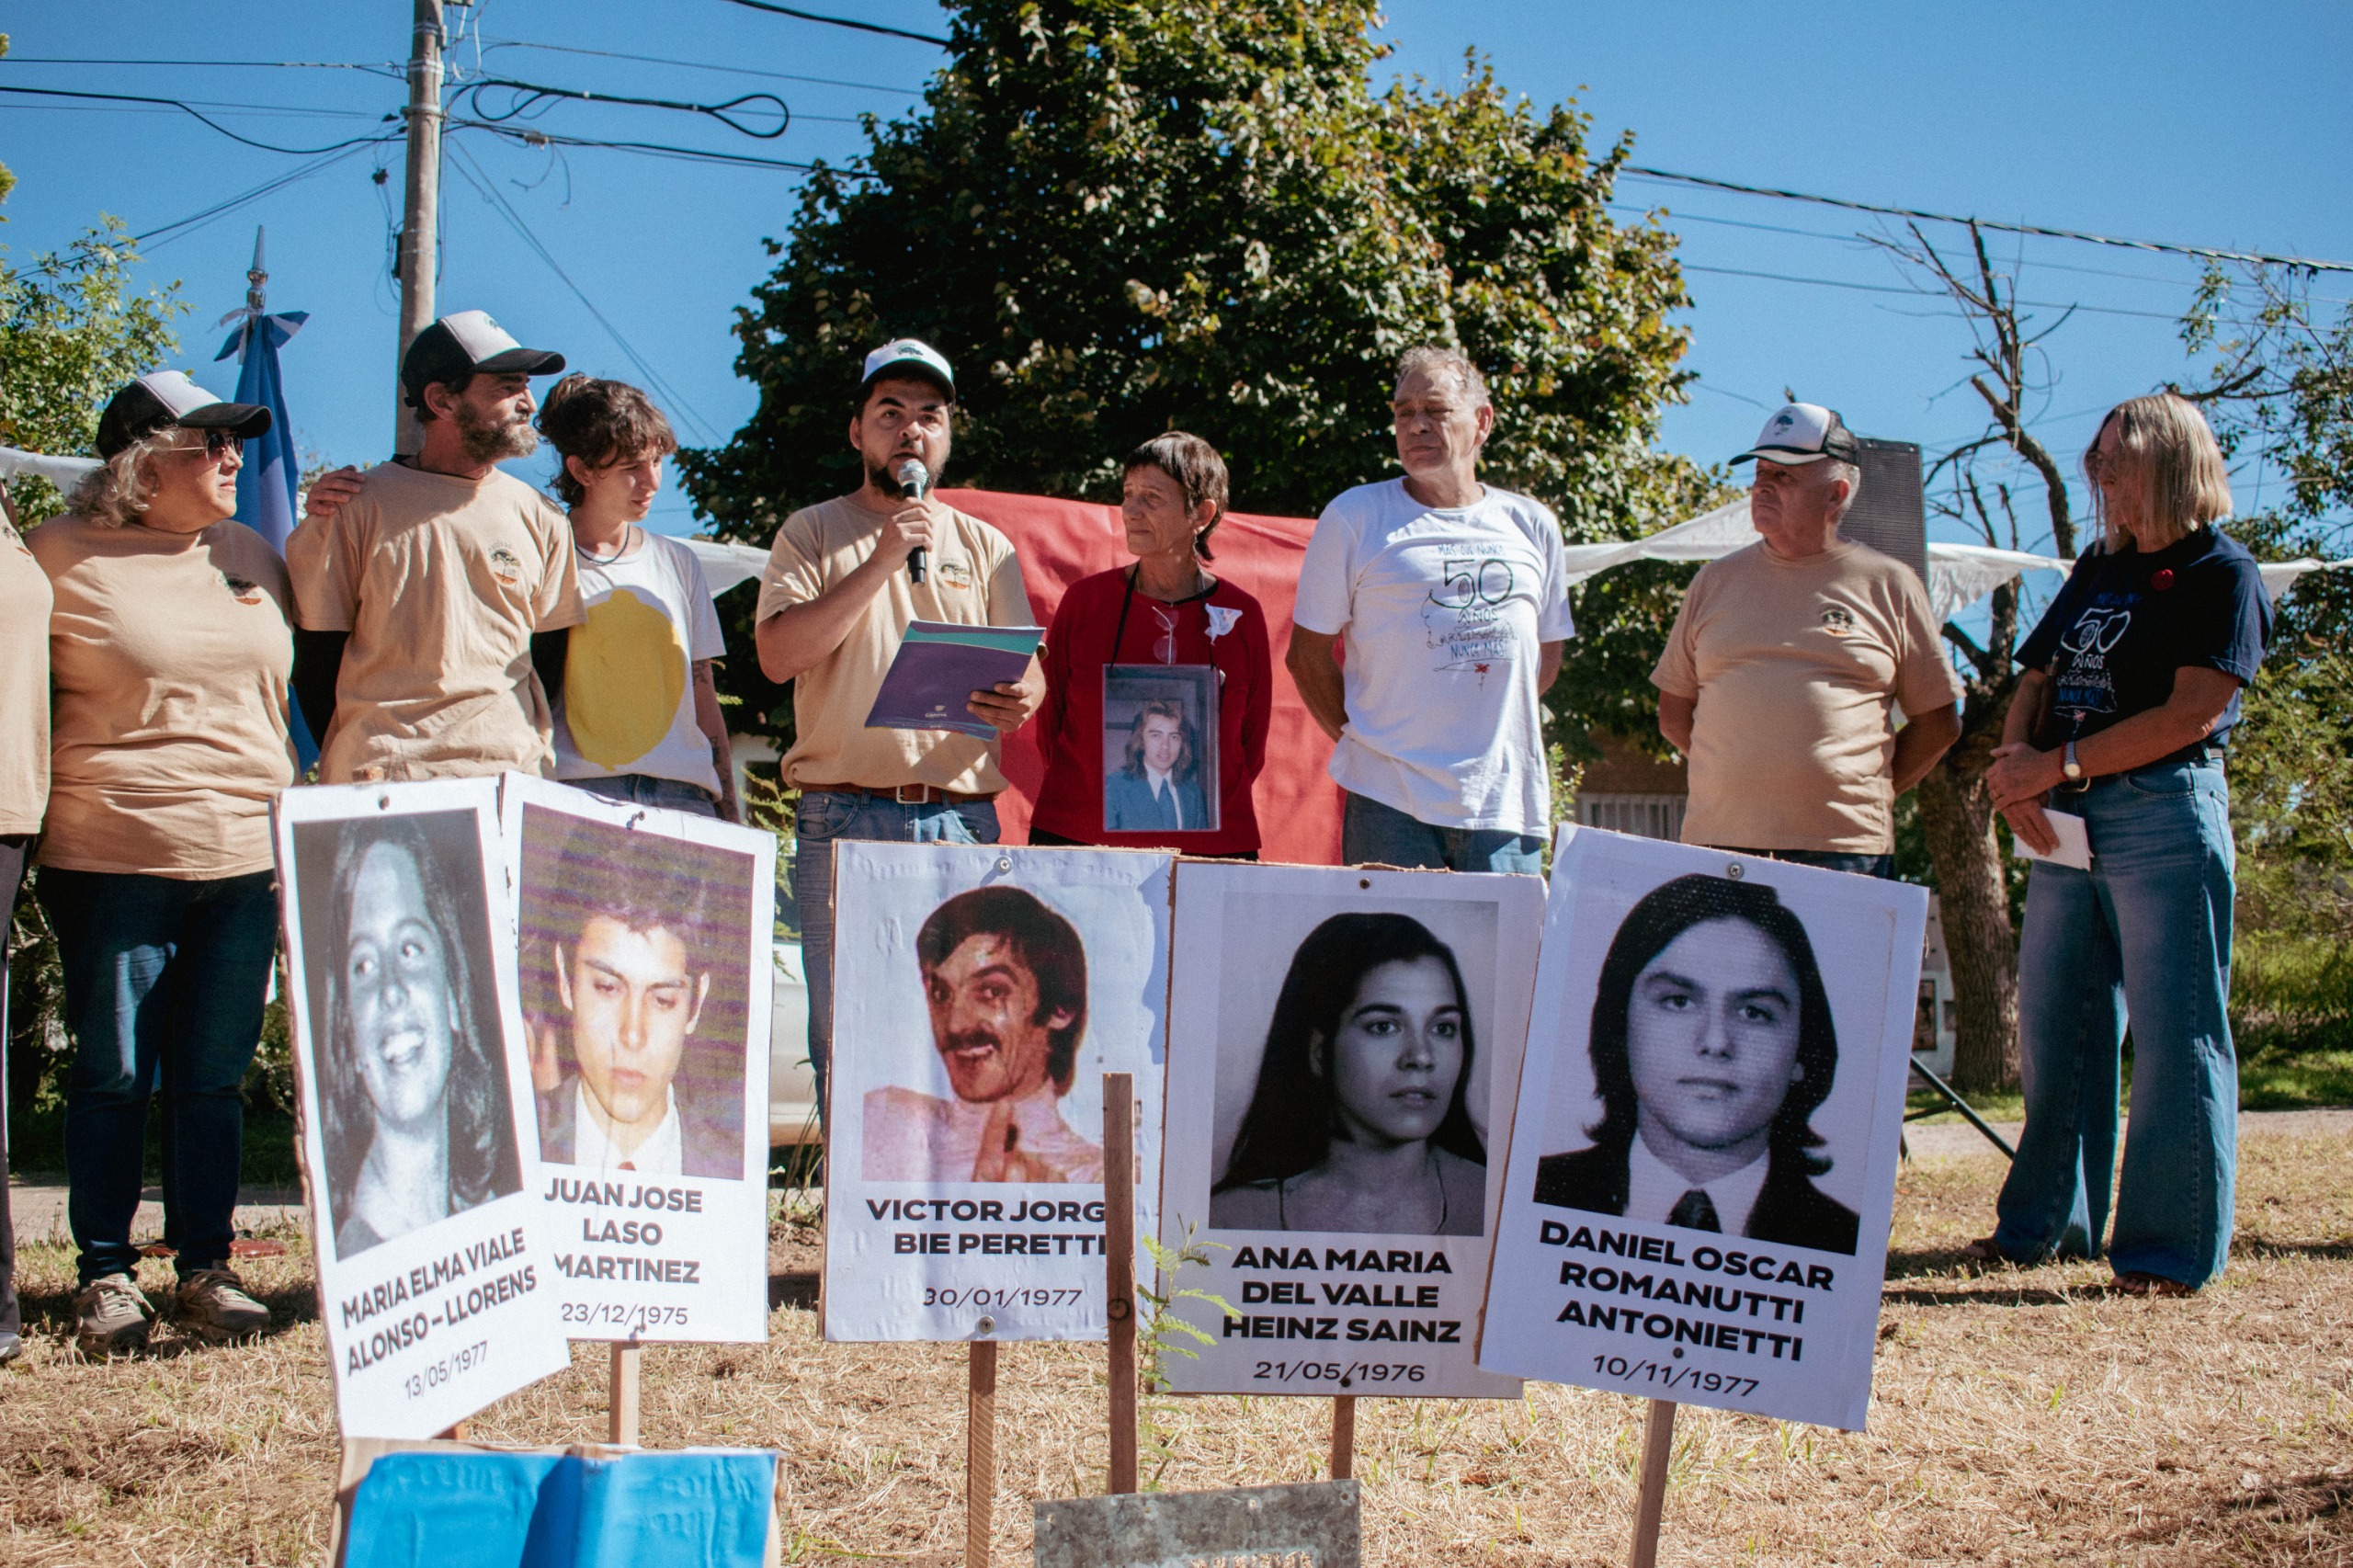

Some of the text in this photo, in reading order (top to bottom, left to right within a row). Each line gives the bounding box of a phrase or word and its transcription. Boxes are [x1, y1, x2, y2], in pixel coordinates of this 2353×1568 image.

[1429, 558, 1513, 608] 50
[1458, 608, 1498, 623] AÑOS
[2061, 608, 2131, 653] 50
[2072, 653, 2105, 669] AÑOS
[544, 1177, 703, 1212] JUAN JOSE
[866, 1199, 1105, 1222] VICTOR JORG
[584, 1218, 663, 1245] LASO
[894, 1233, 1107, 1255] BIE PERETTI
[554, 1253, 699, 1284] MARTINEZ
[1232, 1246, 1453, 1274] ANA MARIA
[1540, 1220, 1835, 1291] DANIEL OSCAR
[342, 1227, 526, 1329] MARIA ELMA VIALE
[1559, 1261, 1804, 1324] ROMANUTTI
[923, 1287, 1083, 1308] 30/01/1977
[1242, 1280, 1439, 1308] DEL VALLE
[348, 1312, 429, 1376] ALONSO
[445, 1265, 537, 1326] LLORENS
[562, 1302, 688, 1326] 23/12/1975
[1222, 1314, 1461, 1343] HEINZ SAINZ
[1556, 1300, 1802, 1361] ANTONIETTI
[405, 1340, 488, 1399] 13/05/1977
[1253, 1360, 1425, 1382] 21/05/1976
[1593, 1354, 1760, 1397] 10/11/1977
